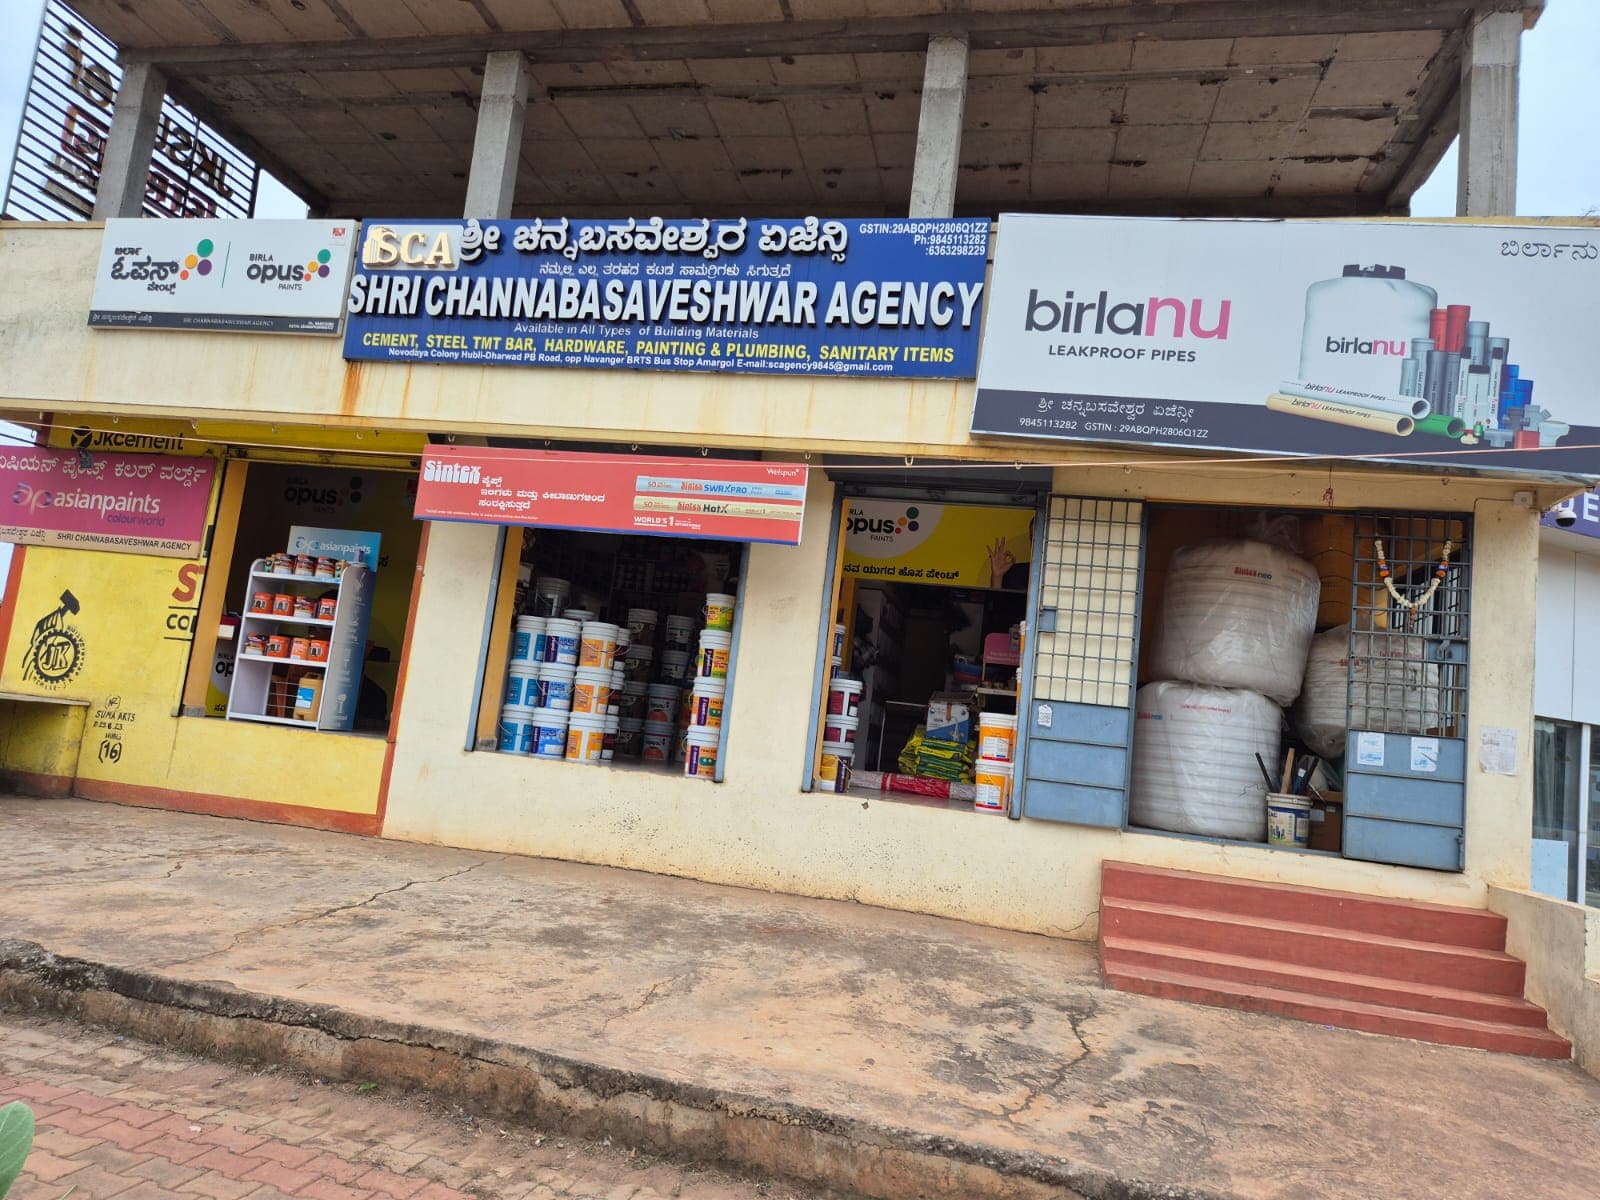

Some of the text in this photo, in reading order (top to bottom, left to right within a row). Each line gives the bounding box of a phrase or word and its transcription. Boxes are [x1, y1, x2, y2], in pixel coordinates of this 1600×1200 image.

[859, 222, 988, 234] GSTIN:29ABQPH2806Q1ZZ
[377, 230, 454, 266] SCA
[460, 216, 848, 262] ಶ್ರೀ ಚನ್ನಬಸವೇಶ್ವರ ಏಜೆನ್ಸಿ
[914, 234, 986, 245] Ph:9845113282
[249, 253, 274, 262] BIRLA
[1501, 240, 1598, 261] ಬಿರ್ಲಾನು
[111, 255, 179, 281] ಓಪಸ್
[247, 263, 305, 284] opus
[602, 261, 640, 276] ತರಹದ
[746, 263, 792, 279] ಸಿಗುತ್ತದೆ
[278, 283, 303, 291] PAINTS
[348, 274, 984, 328] SHRI CHANNABASAVESHWAR AGENCY
[1025, 289, 1232, 340] birlanu
[514, 323, 759, 339] Available in All Types of Building Materials
[362, 332, 955, 363] CEMENT, STEEL TMT BAR, HARDWARE, PAINTING & PLUMBING, SANITARY ITEMS
[1048, 345, 1197, 362] LEAKPROOF PIPES
[1325, 335, 1407, 357] birlanu
[389, 348, 429, 359] Novodaya
[431, 349, 459, 360] Colony
[461, 350, 522, 360] Hubli-Dharwad
[565, 356, 582, 364] opp
[584, 355, 624, 365] Navanger
[627, 356, 652, 365] BRTS
[654, 356, 672, 365] Bus
[673, 357, 695, 368] Stop
[696, 358, 735, 369] Amargol
[1037, 397, 1054, 413] ಶ್ರೀ
[1061, 399, 1146, 421] ಚನ್ನಬಸವೇಶ್ವರ
[1019, 417, 1078, 430] 9845113282
[1084, 421, 1112, 432] GSTIN
[114, 460, 156, 479] ಕಲರ್
[423, 459, 482, 485] Sintex
[53, 488, 161, 519] asianpaints
[284, 486, 338, 506] opus
[57, 532, 74, 541] SHRI
[75, 533, 160, 549] CHANNABASAVESHWAR
[160, 541, 192, 551] AGENCY
[171, 563, 206, 603] S
[98, 740, 123, 764] (16)
